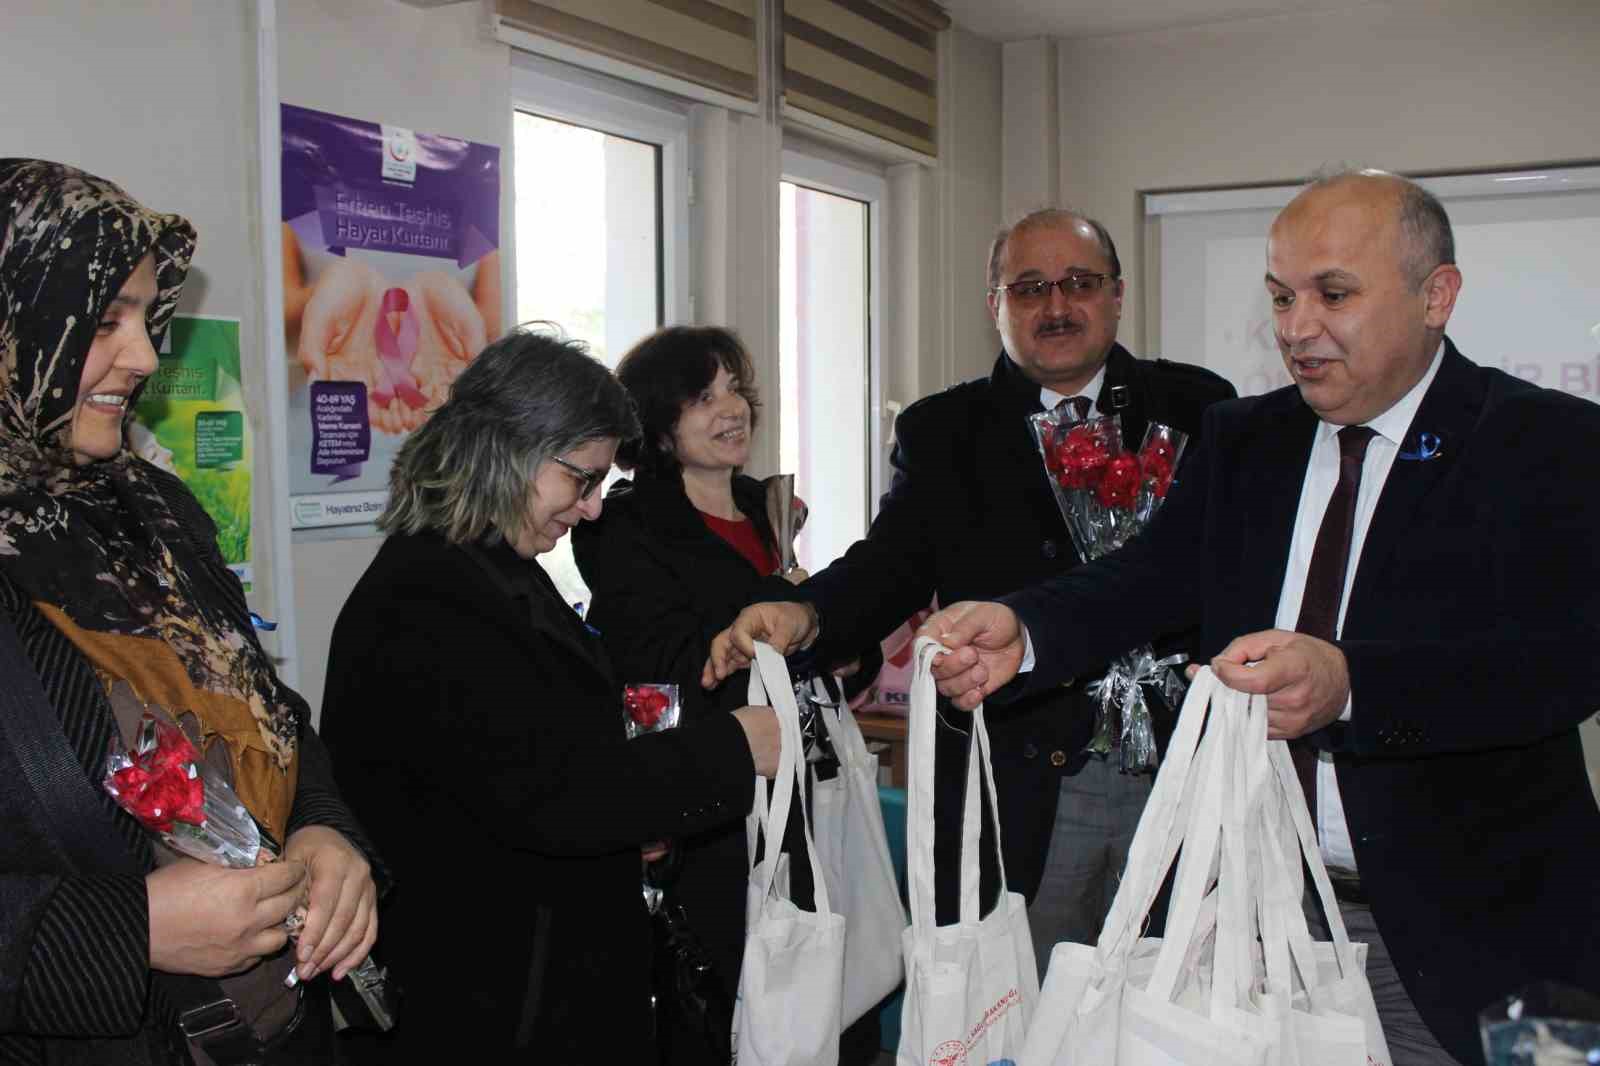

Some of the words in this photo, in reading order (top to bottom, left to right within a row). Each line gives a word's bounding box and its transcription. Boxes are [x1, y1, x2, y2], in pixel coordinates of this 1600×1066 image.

[336, 192, 391, 217] Erken
[393, 202, 452, 229] Teşhis
[336, 217, 387, 245] Hayat
